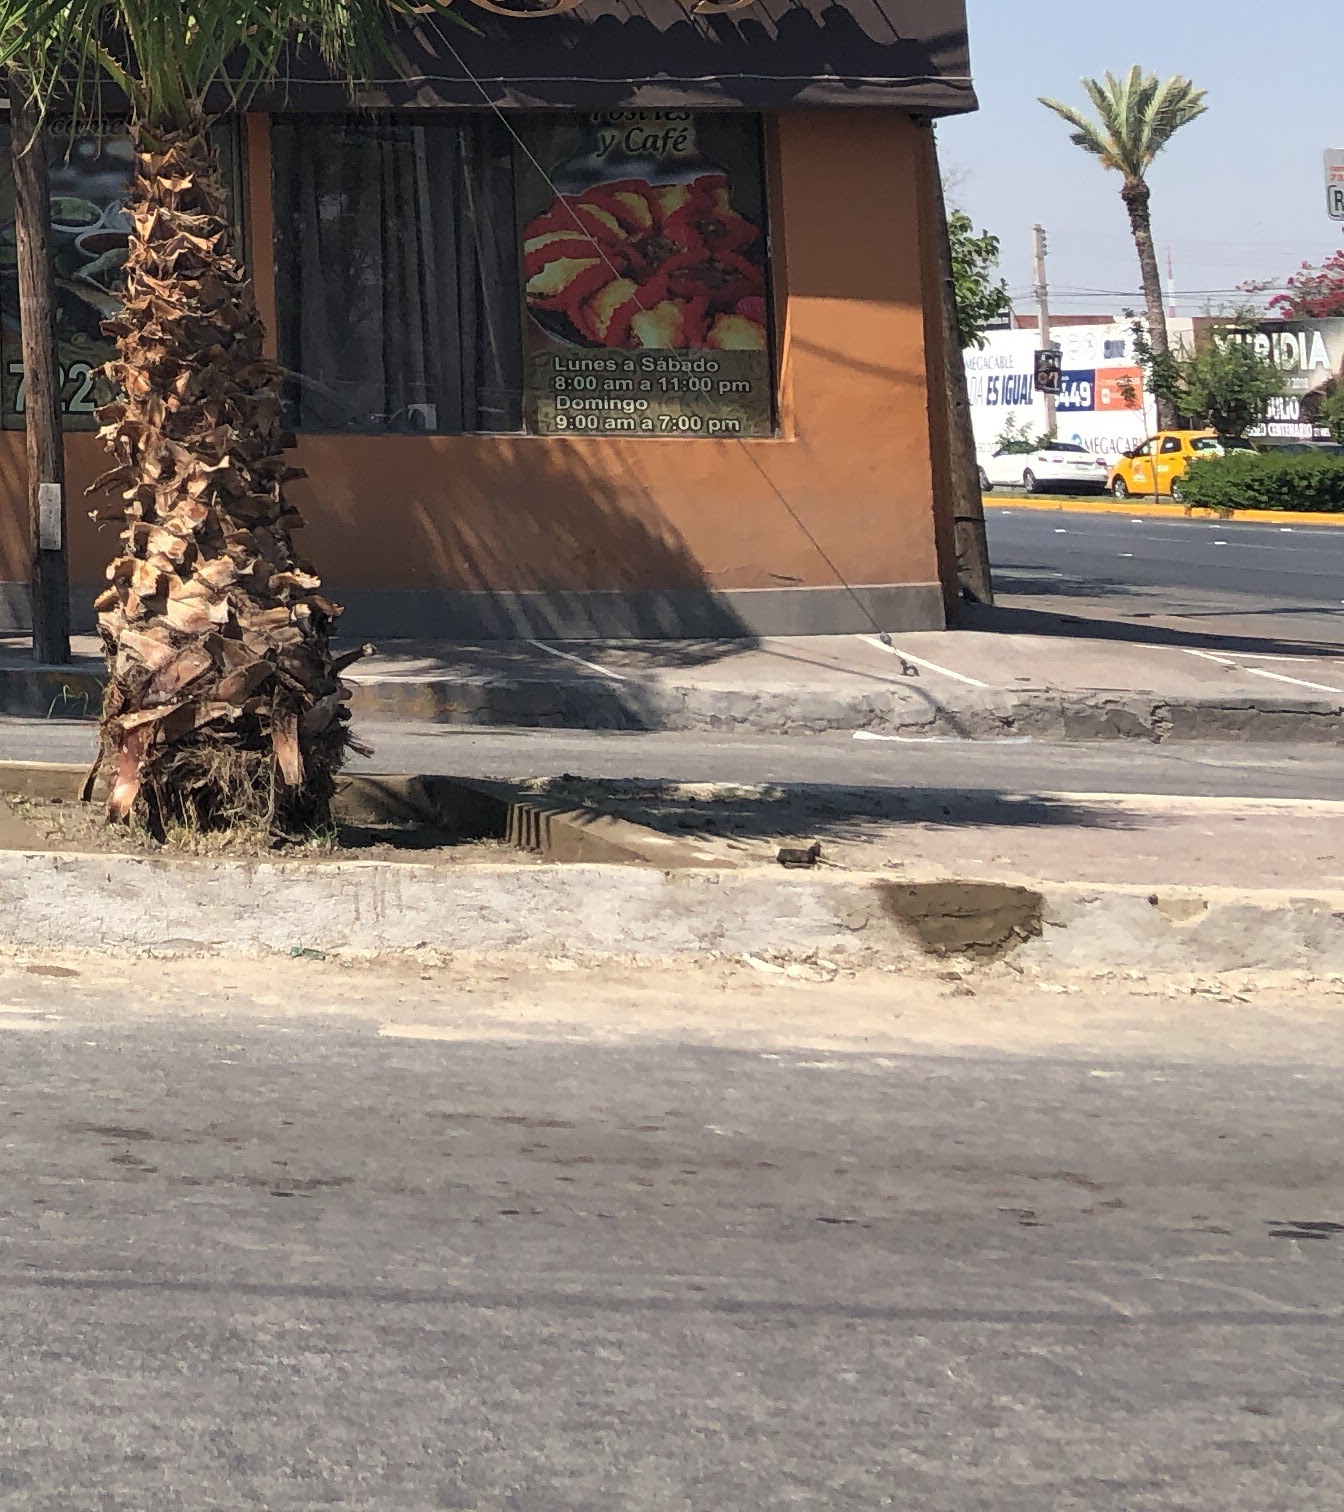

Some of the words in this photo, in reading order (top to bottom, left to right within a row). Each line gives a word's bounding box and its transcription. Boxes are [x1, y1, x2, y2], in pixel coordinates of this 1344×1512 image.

[596, 132, 615, 158] y
[624, 127, 689, 156] Café
[555, 357, 617, 371] Lunes
[623, 360, 635, 371] a
[641, 357, 719, 372] Sábado
[555, 376, 597, 390] 8:00
[603, 379, 633, 390] am
[640, 379, 651, 391] a
[658, 377, 712, 391] 11:00
[719, 381, 751, 394] pm
[986, 376, 999, 406] ES
[1001, 374, 1033, 405] IGUAL
[556, 395, 648, 414] Domingo
[556, 415, 598, 429] 9:00
[605, 418, 635, 430] am
[641, 418, 653, 430] a
[659, 416, 702, 431] 7:00
[709, 419, 740, 433] pm
[1085, 437, 1145, 455] MEGACAB
